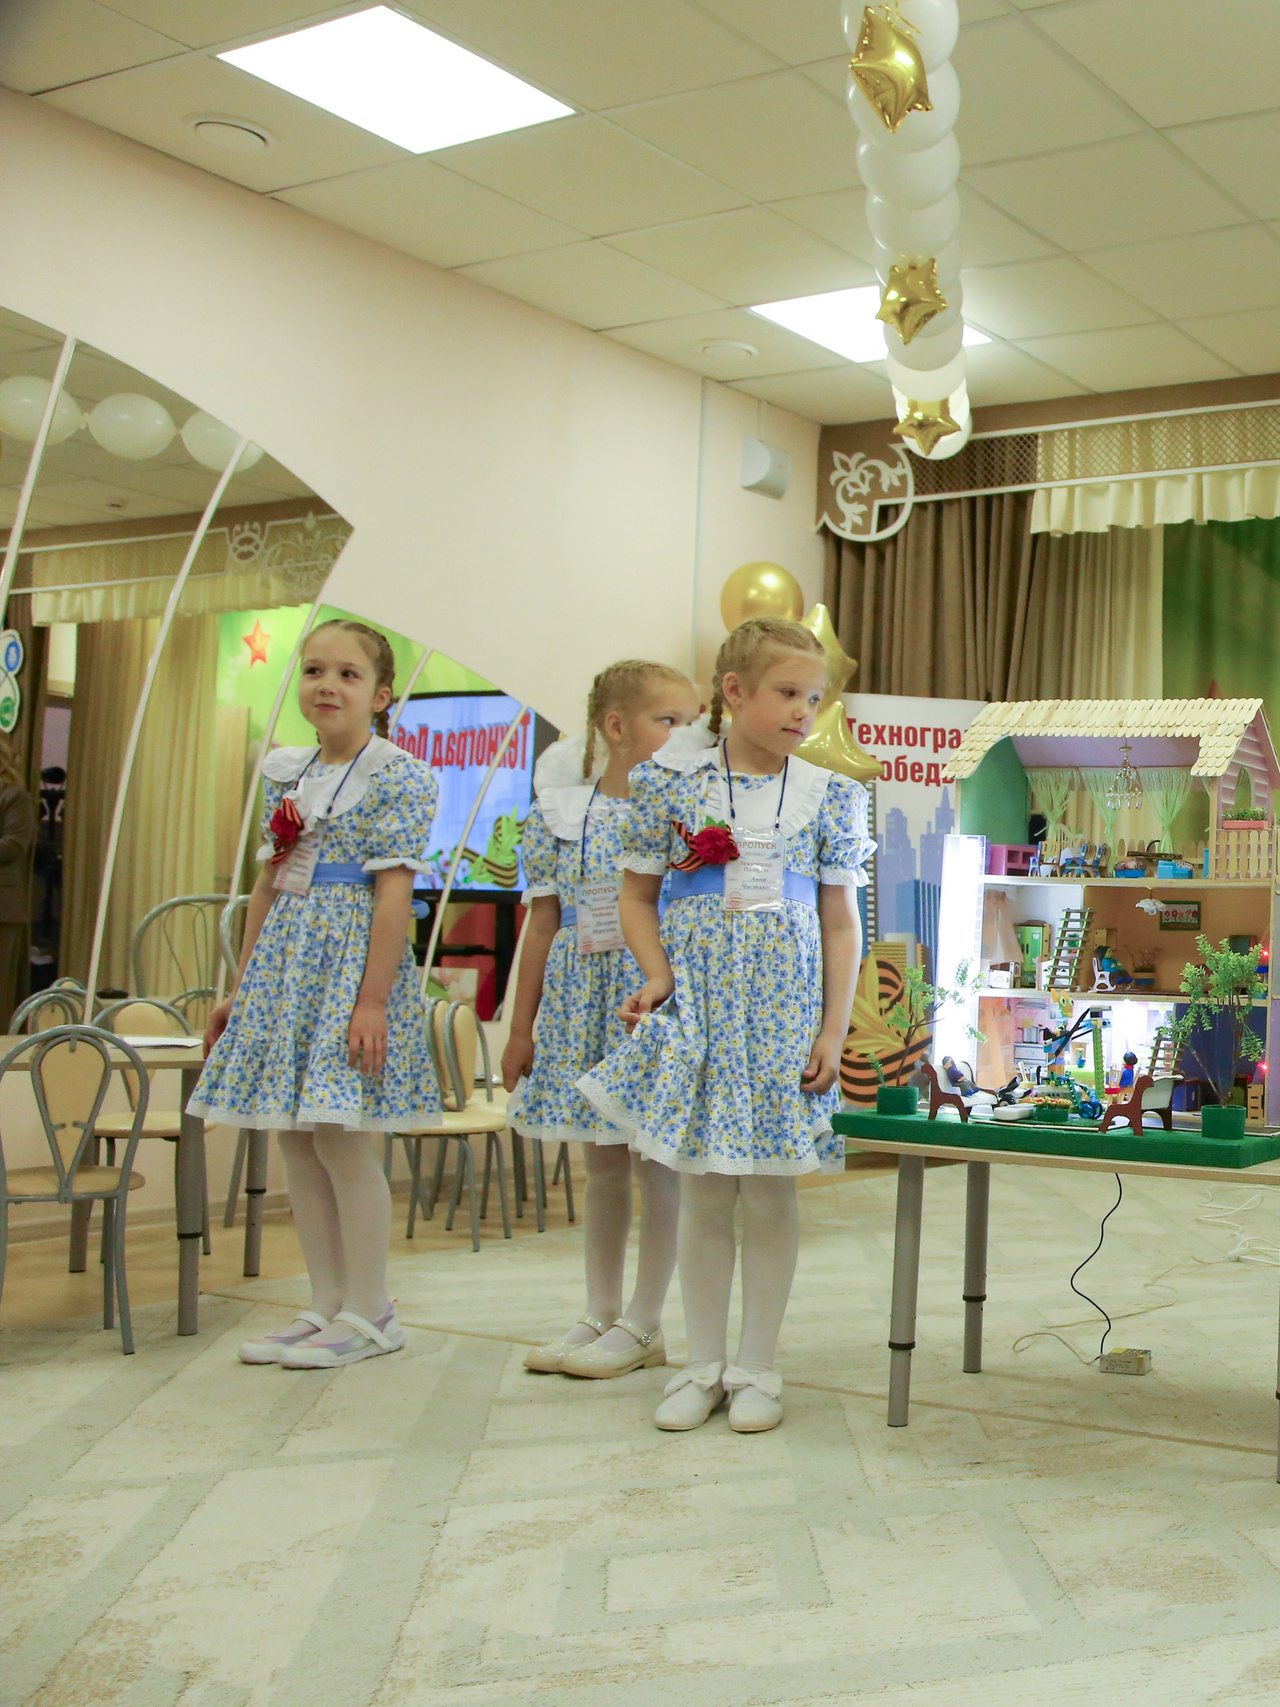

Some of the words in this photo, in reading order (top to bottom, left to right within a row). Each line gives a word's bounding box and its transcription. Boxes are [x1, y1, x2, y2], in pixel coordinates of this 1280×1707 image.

[846, 717, 968, 753] Техногра
[868, 754, 955, 787] обед
[736, 841, 777, 850] ПРОПУСК
[582, 886, 617, 896] ПРОПУСК
